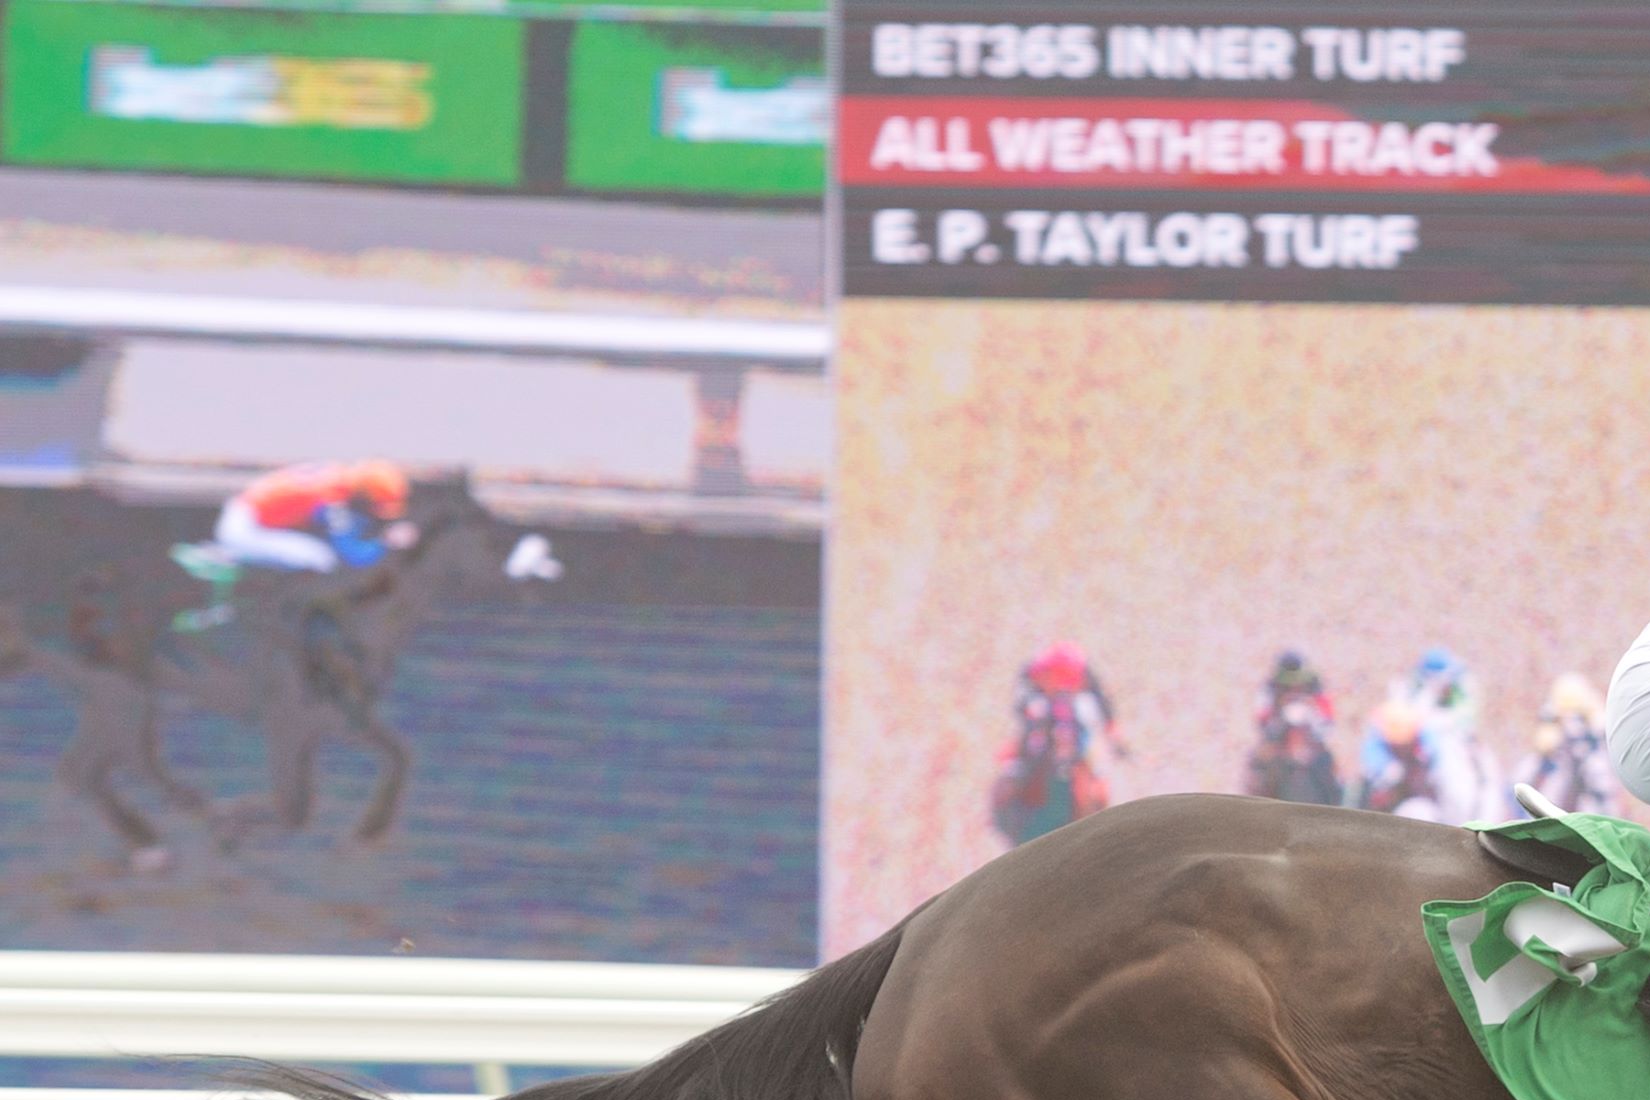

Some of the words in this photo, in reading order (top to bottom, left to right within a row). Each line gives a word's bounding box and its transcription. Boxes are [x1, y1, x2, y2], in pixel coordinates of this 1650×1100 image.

[872, 24, 1098, 77] BET365
[1109, 27, 1296, 79] INNER
[1304, 29, 1464, 81] TURF
[871, 117, 984, 170] ALL
[990, 119, 1285, 173] WEATHER
[1295, 122, 1497, 176] TRACK
[873, 210, 930, 263] E.
[936, 211, 998, 263] P.
[1006, 213, 1249, 265] TAYLOR
[1257, 216, 1419, 267] TURF
